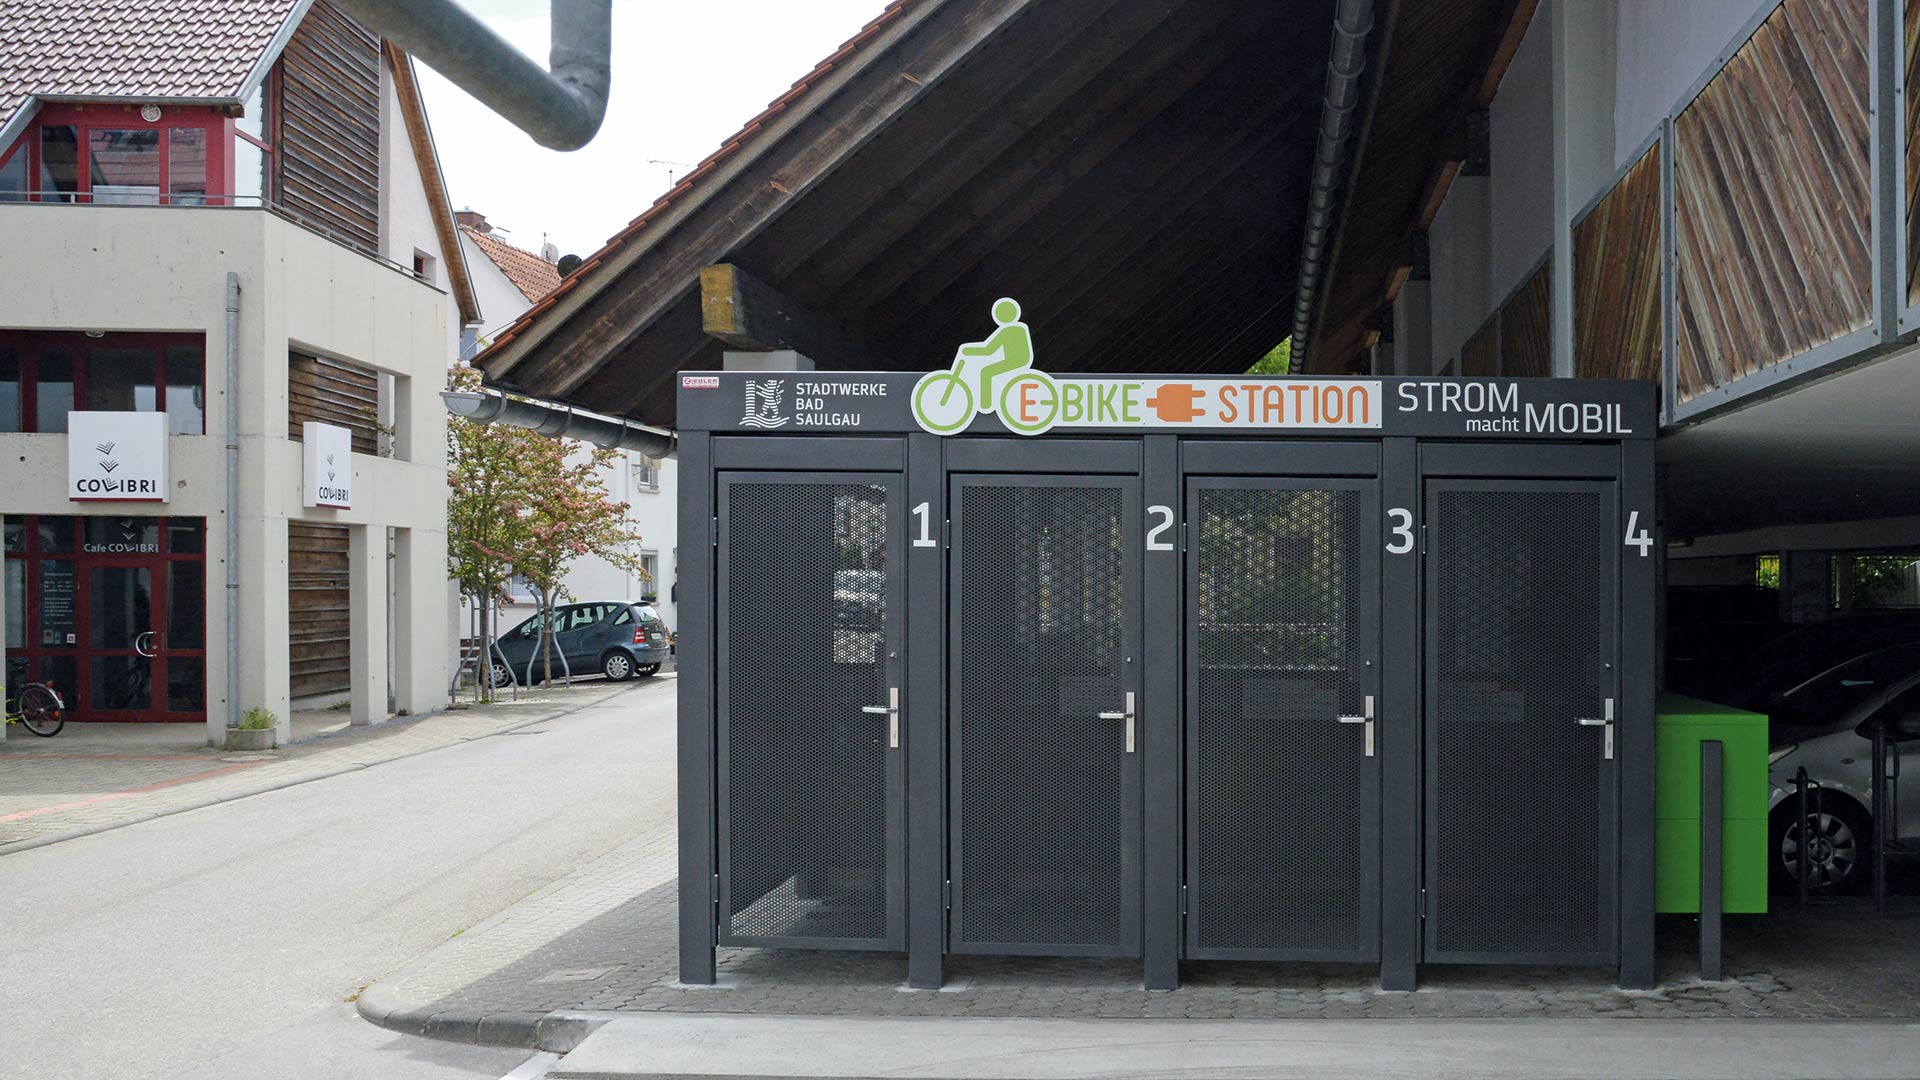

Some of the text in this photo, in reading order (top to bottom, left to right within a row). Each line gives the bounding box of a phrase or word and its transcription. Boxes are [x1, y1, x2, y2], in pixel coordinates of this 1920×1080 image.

[795, 398, 824, 411] BAD
[796, 382, 888, 396] STADTWERKE
[1218, 384, 1369, 424] STATION
[1398, 382, 1518, 413] STROM
[795, 413, 861, 426] SAULGAU
[1466, 402, 1633, 434] macht MOBIL
[76, 478, 156, 493] COLIBRI
[911, 502, 937, 548] 1
[1146, 505, 1175, 551] 2
[1385, 508, 1414, 554] 3
[1624, 511, 1654, 557] 4
[83, 543, 107, 553] Cafe
